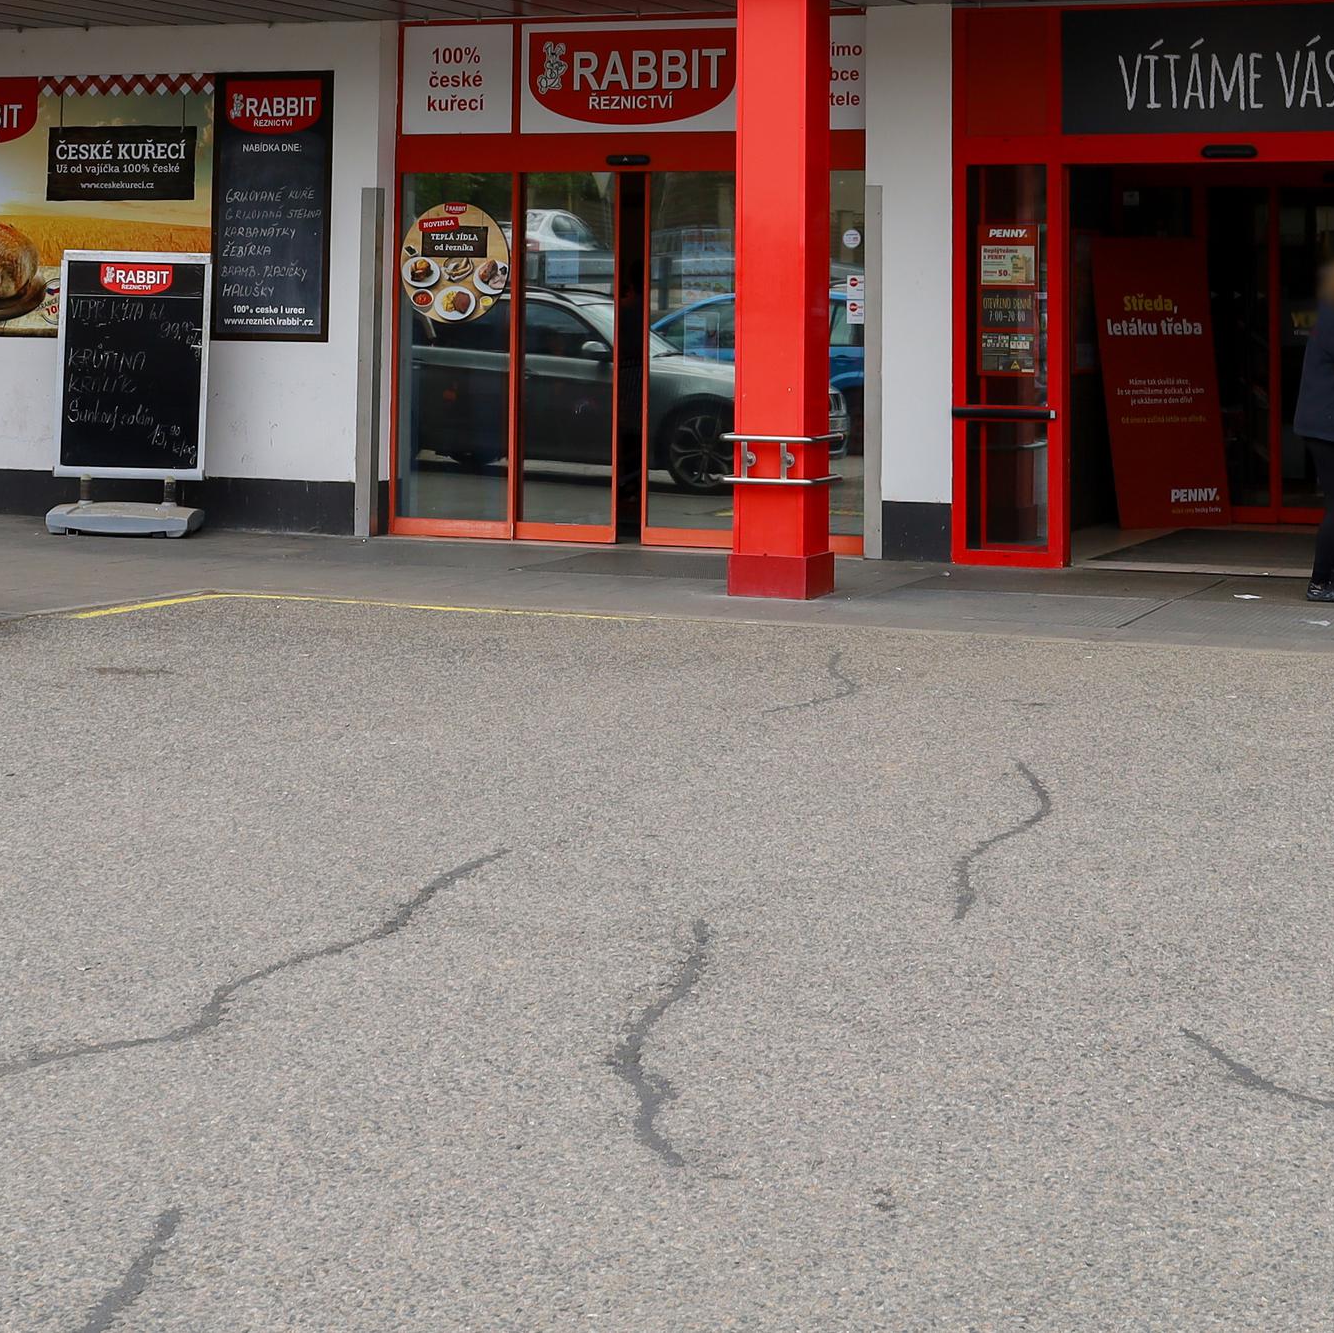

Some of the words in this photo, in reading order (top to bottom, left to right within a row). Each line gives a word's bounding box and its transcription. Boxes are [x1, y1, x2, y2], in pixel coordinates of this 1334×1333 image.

[432, 46, 481, 64] 100%
[830, 41, 863, 56] ímo
[573, 48, 727, 91] RABBIT
[830, 67, 860, 81] bce
[1118, 38, 1264, 111] VÍTÁME
[429, 70, 483, 88] české
[427, 94, 485, 112] kuřecí
[589, 91, 674, 110] ŘEZNICTVÍ
[830, 91, 860, 106] tele
[246, 97, 316, 117] RABBIT
[253, 117, 292, 127] ŘEZNICTVÍ
[56, 140, 113, 160] ČESKÉ
[118, 139, 186, 160] KUŘECÍ
[242, 142, 280, 152] NABÍDKA
[282, 144, 302, 152] DNE:
[56, 165, 68, 174] Už
[70, 164, 82, 173] od
[85, 164, 120, 176] vajíčka
[123, 164, 149, 173] 100%
[153, 163, 179, 173] české
[80, 181, 154, 189] www.ceskekureci.cz
[423, 219, 454, 228] NOVINKA
[430, 232, 454, 241] TEPLÁ
[456, 232, 478, 241] JÍDLA
[445, 244, 474, 252] řezníka
[116, 270, 169, 284] RABBIT
[1123, 293, 1178, 314] Středa,
[1107, 317, 1158, 336] letáku
[1161, 317, 1203, 335] třeba
